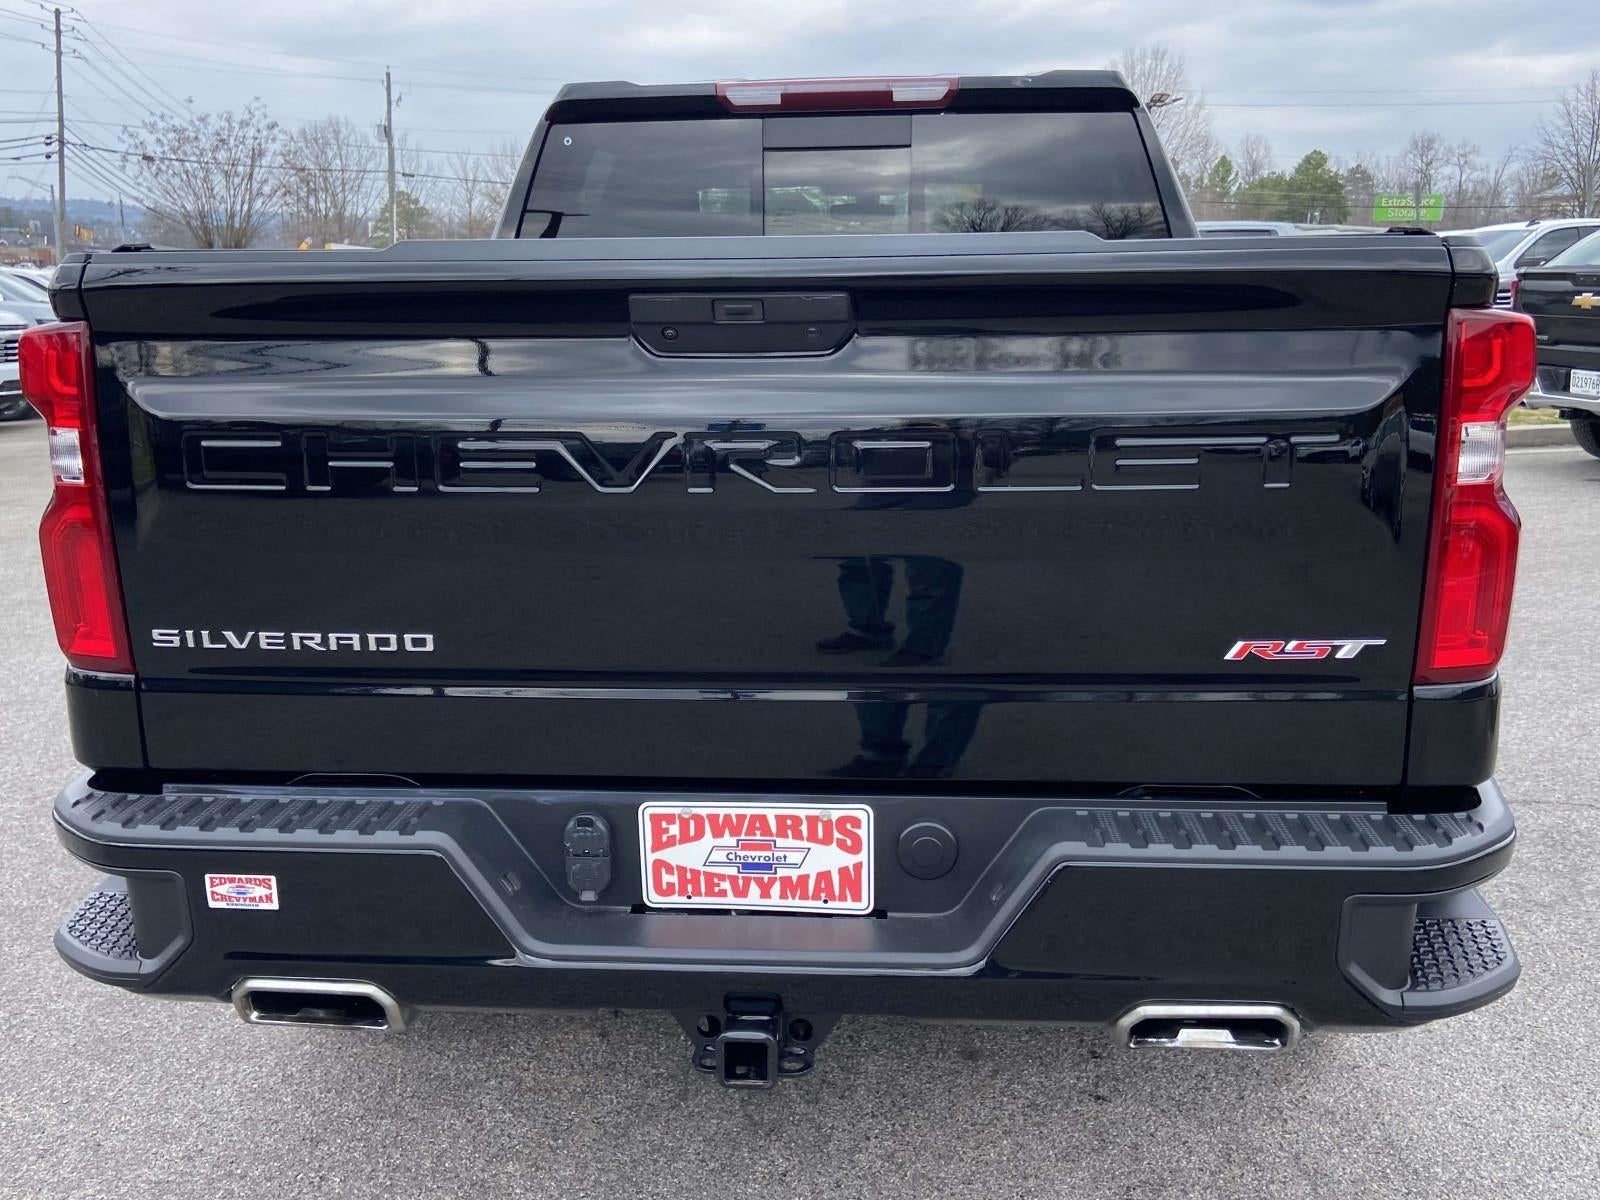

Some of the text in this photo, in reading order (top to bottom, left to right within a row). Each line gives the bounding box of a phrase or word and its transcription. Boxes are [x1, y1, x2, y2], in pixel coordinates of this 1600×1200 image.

[181, 430, 1341, 493] CHEVROLET
[151, 628, 435, 653] SILVERADO
[1223, 638, 1387, 661] RST
[649, 812, 863, 856] EDWARDS
[725, 851, 788, 864] Chevrolet
[208, 876, 273, 891] EDWARDS
[651, 858, 864, 903] CHEVYMAN
[210, 890, 274, 904] CHEVYMAN
